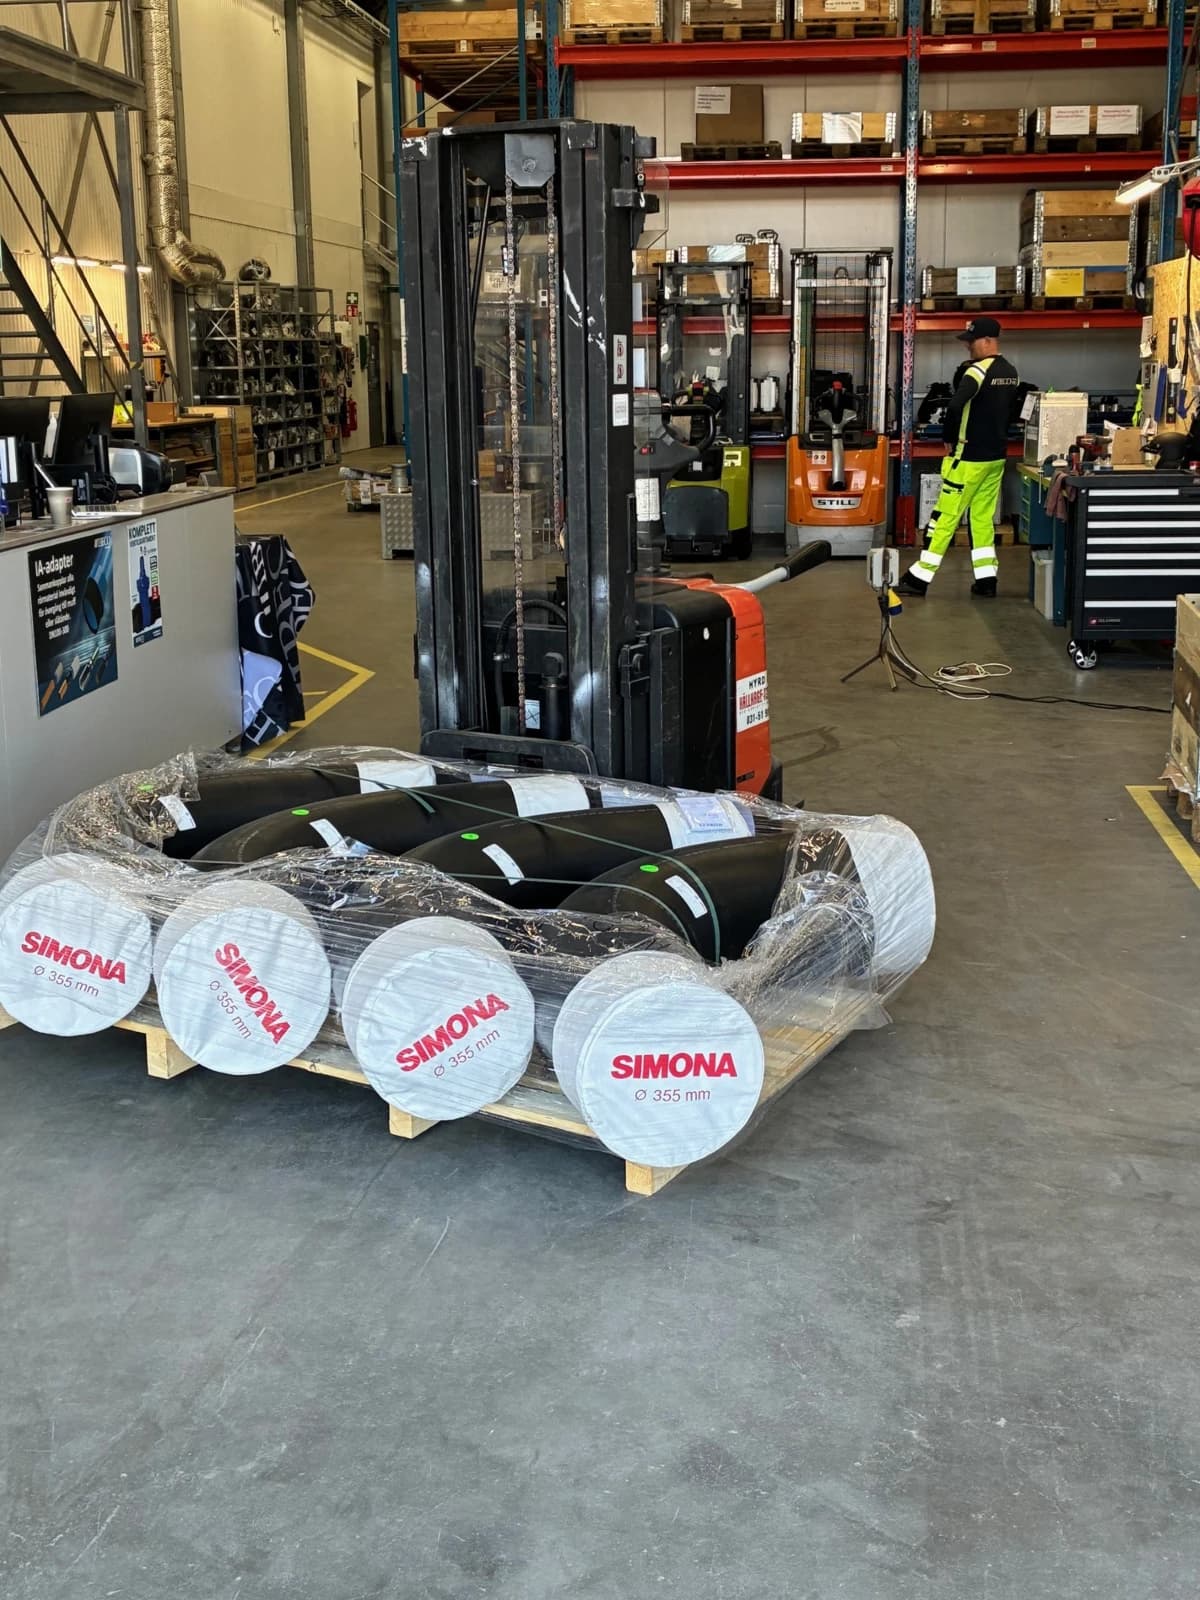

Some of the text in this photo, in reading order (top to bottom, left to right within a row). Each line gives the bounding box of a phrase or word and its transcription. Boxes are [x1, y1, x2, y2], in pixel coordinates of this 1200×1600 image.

[128, 522, 156, 539] KOMPLETT
[21, 931, 126, 984] SIMONA
[48, 970, 74, 988] 355
[75, 981, 100, 997] mm
[215, 943, 291, 1044] SIMONA
[217, 991, 239, 1015] 355
[231, 1016, 252, 1039] mm
[396, 993, 511, 1072] SIMONA
[448, 1045, 475, 1068] 355
[475, 1029, 501, 1051] mm
[610, 1052, 738, 1079] SIMONA
[653, 1089, 681, 1102] 355
[685, 1089, 711, 1102] mm
